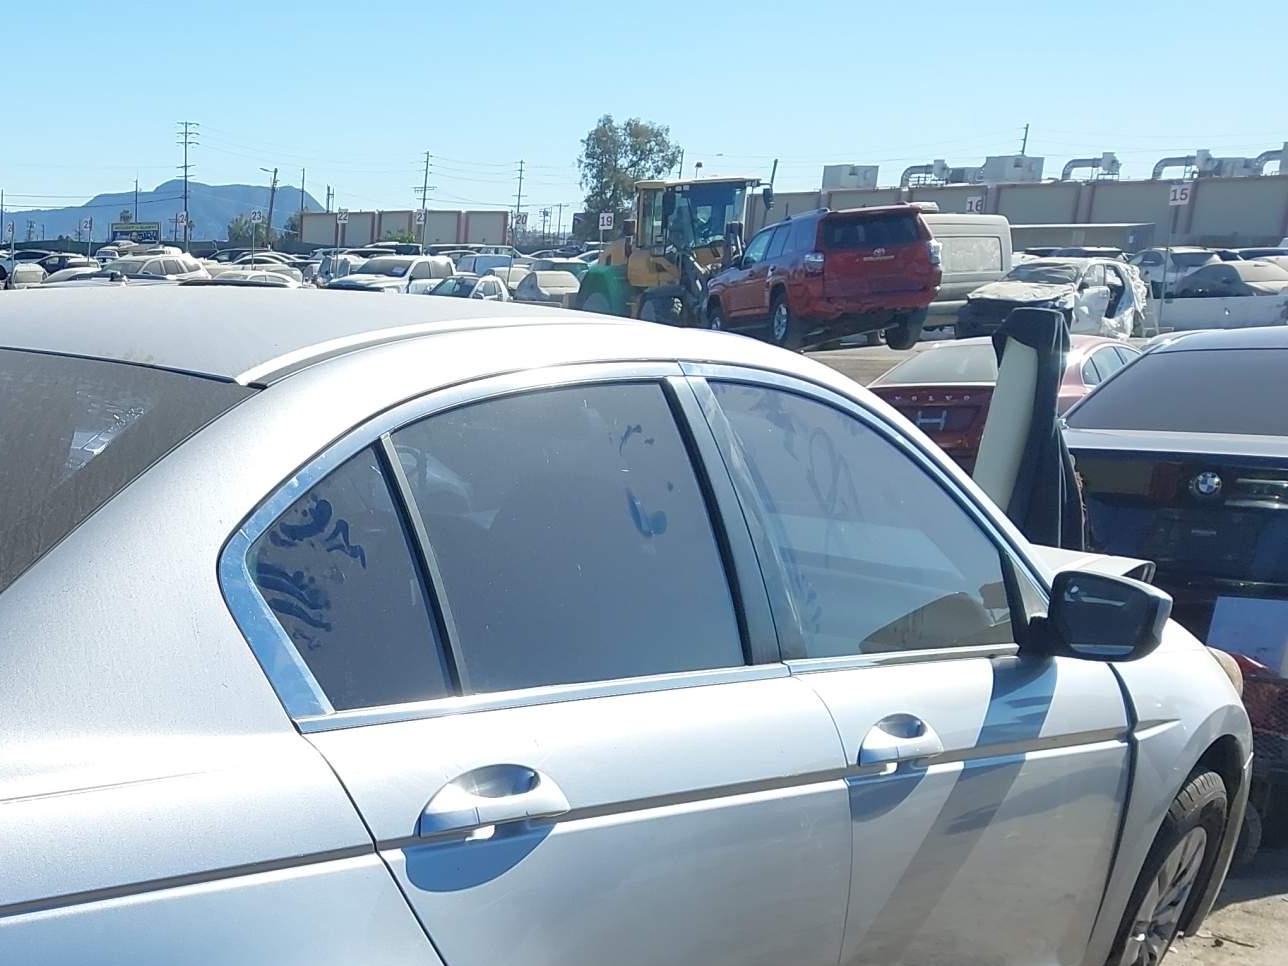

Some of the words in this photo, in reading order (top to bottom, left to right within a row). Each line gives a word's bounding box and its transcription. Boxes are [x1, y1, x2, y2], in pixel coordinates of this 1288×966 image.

[1171, 187, 1188, 201] 15
[967, 200, 983, 213] 16
[251, 210, 262, 221] 23
[337, 211, 348, 221] 22
[516, 214, 527, 225] 20
[600, 215, 613, 227] 19
[894, 394, 971, 402] VOLVO
